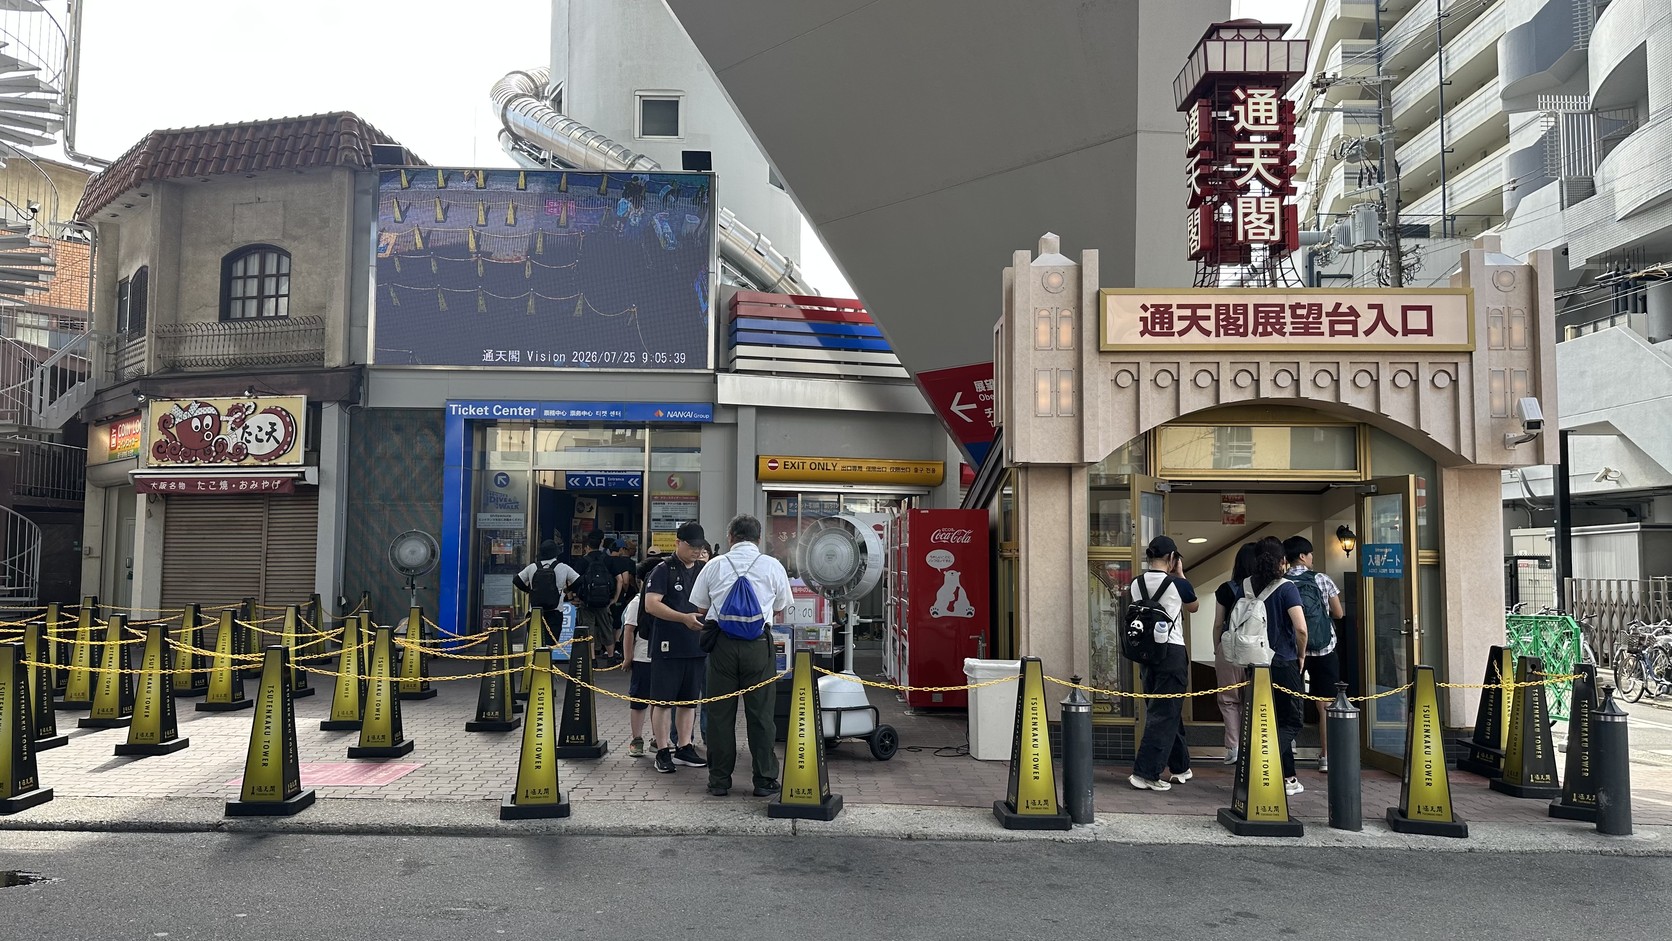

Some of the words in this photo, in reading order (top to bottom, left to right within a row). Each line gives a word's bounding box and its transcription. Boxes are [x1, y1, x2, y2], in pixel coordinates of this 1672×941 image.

[1233, 87, 1281, 243] 通天閣
[1185, 101, 1202, 262] 通天閣
[1138, 302, 1435, 338] 通天閣展望台入口
[482, 349, 520, 363] 通天閣
[527, 350, 566, 363] Vision
[571, 351, 636, 364] 2026/07/25
[641, 351, 686, 364] 9:05:39
[449, 404, 489, 416] Ticket
[493, 404, 537, 417] Center
[666, 410, 693, 418] NANKAI
[693, 411, 710, 419] Group
[240, 421, 281, 445] たこ天
[783, 460, 807, 470] EXIT
[809, 461, 838, 471] ONLY
[150, 481, 186, 491] 大阪名物
[197, 480, 281, 491] たこ焼・おみやげ
[584, 476, 606, 487] 入口
[774, 501, 784, 513] A
[930, 528, 974, 544] Coca-Cola
[146, 654, 156, 694] TSUTNKAKU
[143, 697, 152, 719] TOWER
[264, 684, 275, 736] TSUTENKAKU
[374, 699, 382, 721] TOWER
[573, 699, 581, 721] TOWER
[1487, 676, 1497, 716] TSTENKAKU
[535, 687, 545, 738] TSUTENKAKU
[798, 687, 806, 738] TSUTENKAKU
[1031, 697, 1039, 749] TSUTENKAKU
[1532, 689, 1541, 733] TSUTENKAKU
[1581, 699, 1589, 748] TSUTENKAKU
[1260, 703, 1269, 755] TSUTENKAKU
[1423, 704, 1432, 756] TSUTENKAKU
[261, 740, 271, 768] TOWER
[534, 742, 543, 770] TOWER
[798, 742, 806, 770] TOWER
[1535, 735, 1543, 759] TOWER
[1032, 752, 1040, 781] TOWER
[1262, 759, 1270, 787] TOWER
[1425, 759, 1433, 787] TOWER
[1581, 751, 1589, 777] TOWER
